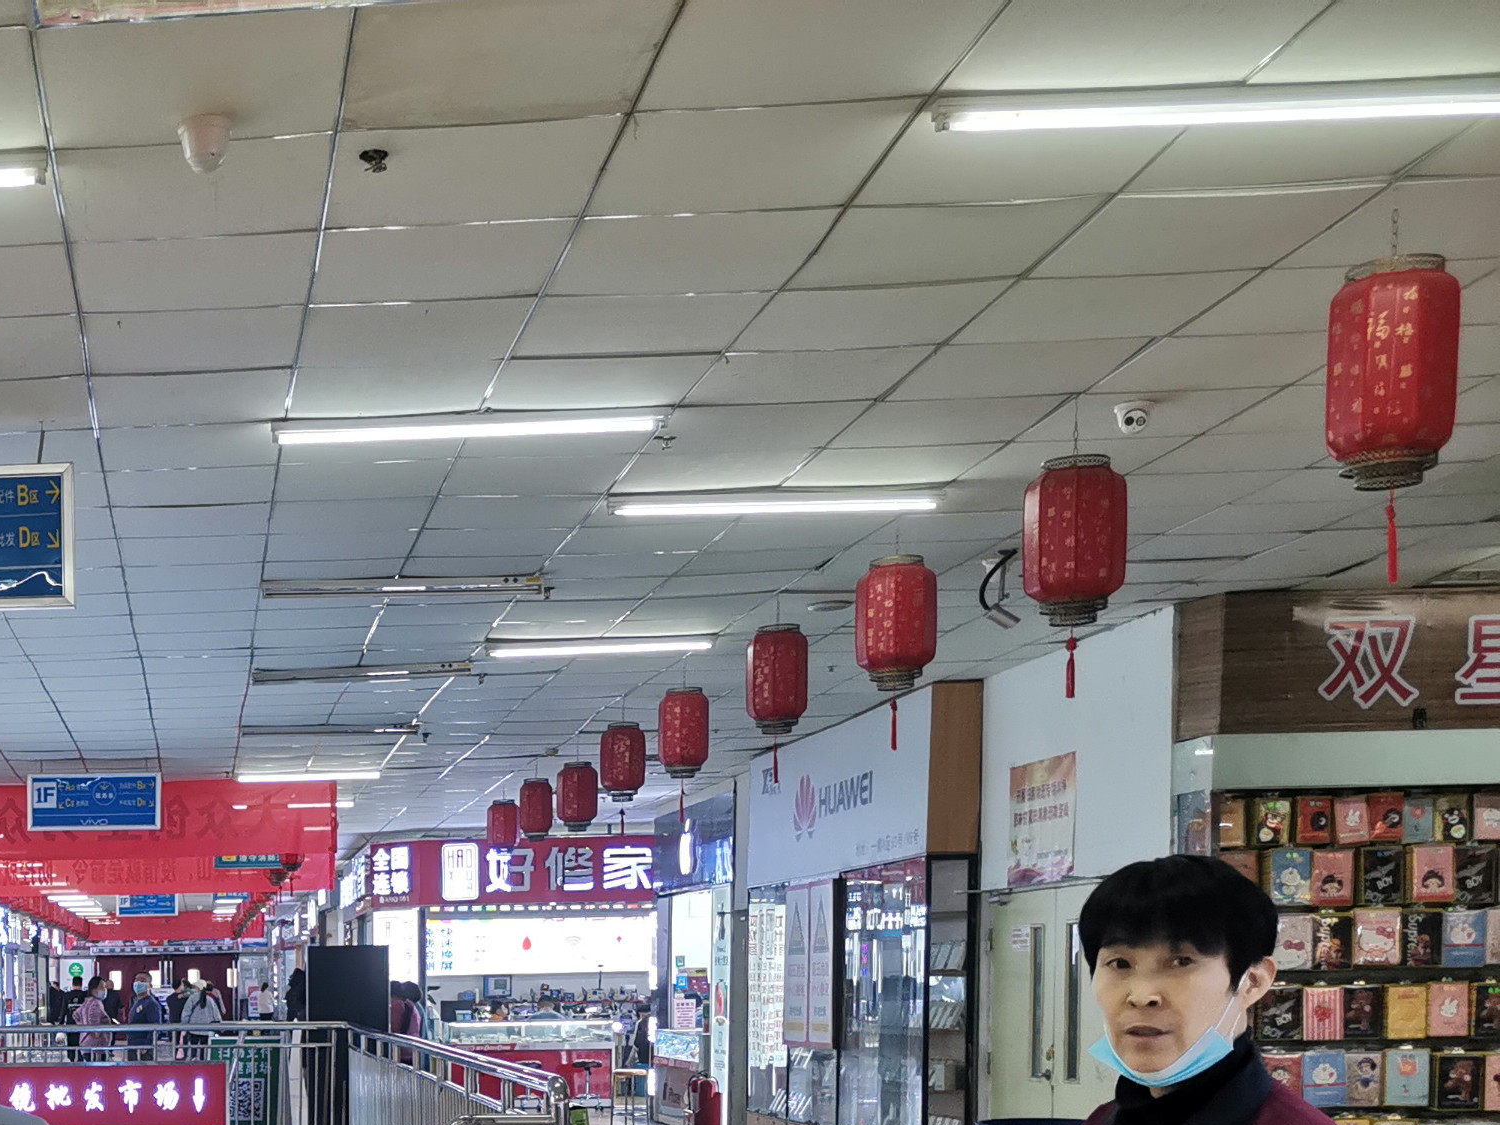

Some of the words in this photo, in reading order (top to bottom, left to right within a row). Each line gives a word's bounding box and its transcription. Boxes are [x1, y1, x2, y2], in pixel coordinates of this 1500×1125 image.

[35, 786, 56, 804] 1F
[818, 769, 874, 819] HUAWEI
[80, 817, 109, 826] vivo
